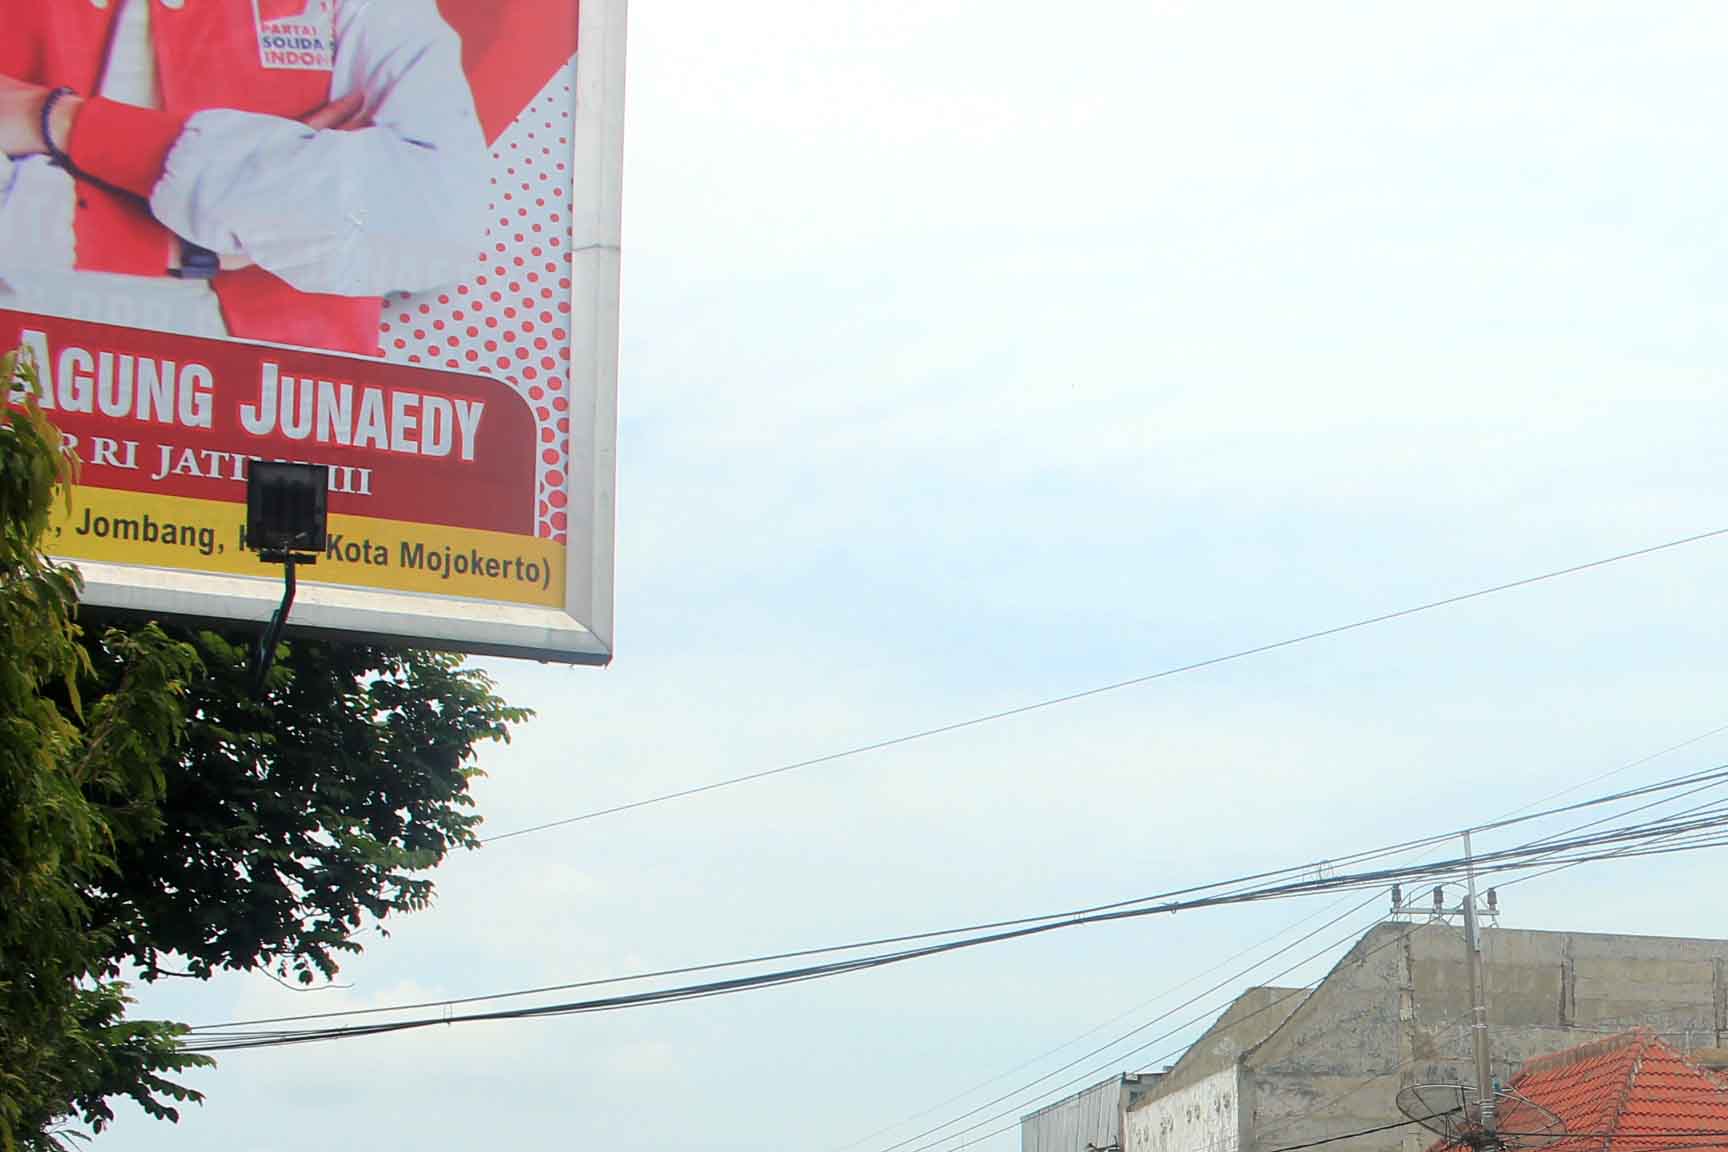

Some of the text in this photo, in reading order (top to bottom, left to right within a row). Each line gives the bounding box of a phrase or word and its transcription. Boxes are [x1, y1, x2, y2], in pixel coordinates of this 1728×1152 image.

[8, 328, 485, 461] AGUNG JUNAEDY
[89, 437, 140, 469] RI
[75, 507, 225, 555] Jombang,
[326, 533, 389, 567] Kota
[399, 540, 551, 591] Mojokerto)
